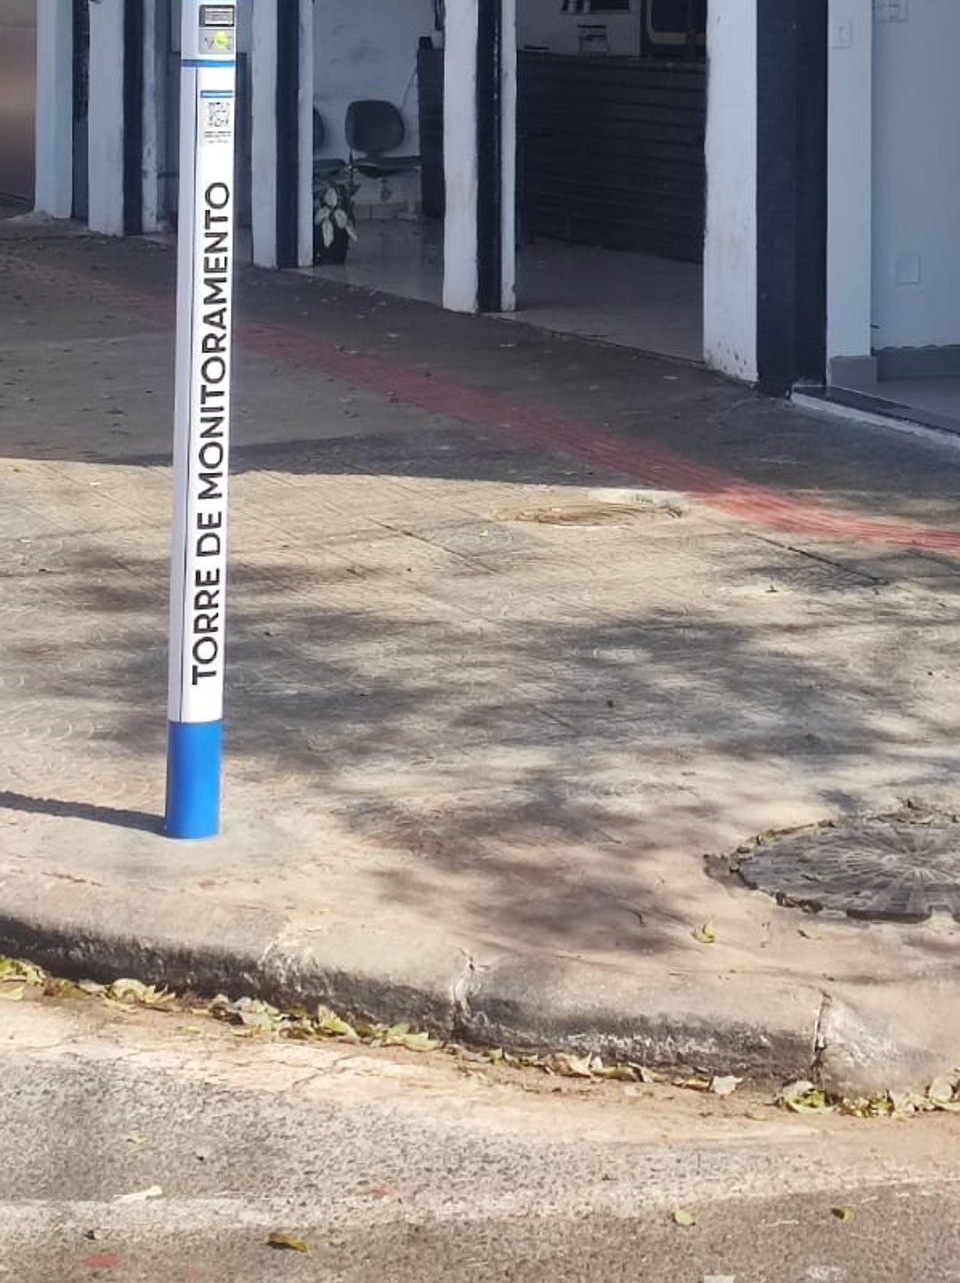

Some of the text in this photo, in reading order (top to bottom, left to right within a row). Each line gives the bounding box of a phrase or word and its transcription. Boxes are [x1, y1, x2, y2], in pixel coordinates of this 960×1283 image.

[197, 181, 231, 500] MONITORAMENTO
[195, 511, 223, 557] DE
[191, 568, 223, 687] TORRE
